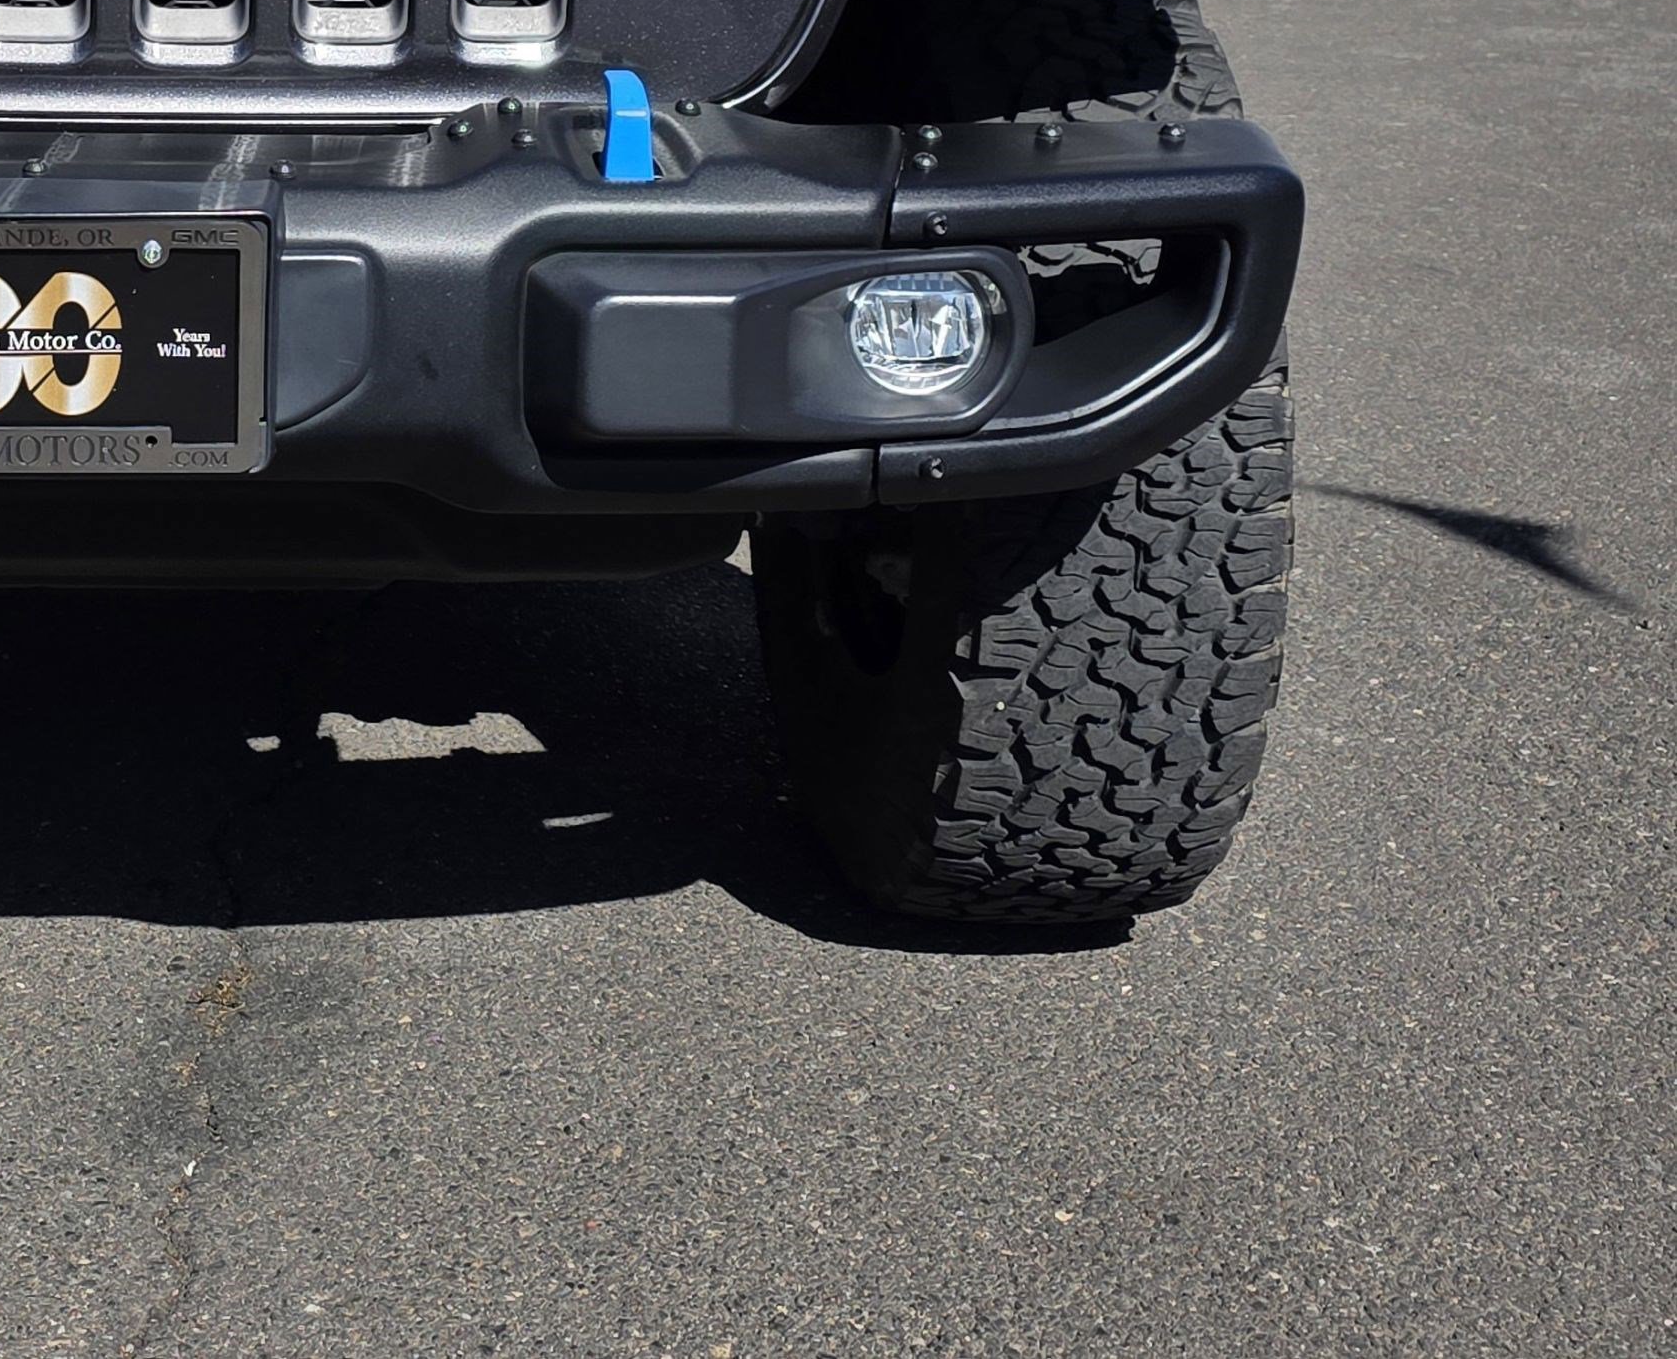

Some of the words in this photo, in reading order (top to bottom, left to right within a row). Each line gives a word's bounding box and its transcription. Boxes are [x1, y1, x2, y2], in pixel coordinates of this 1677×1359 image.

[77, 228, 115, 247] OR
[170, 229, 240, 245] GMC
[7, 329, 78, 350] Motor
[84, 329, 123, 350] Co.
[172, 328, 211, 343] Years
[156, 342, 192, 358] With
[194, 343, 227, 358] You!
